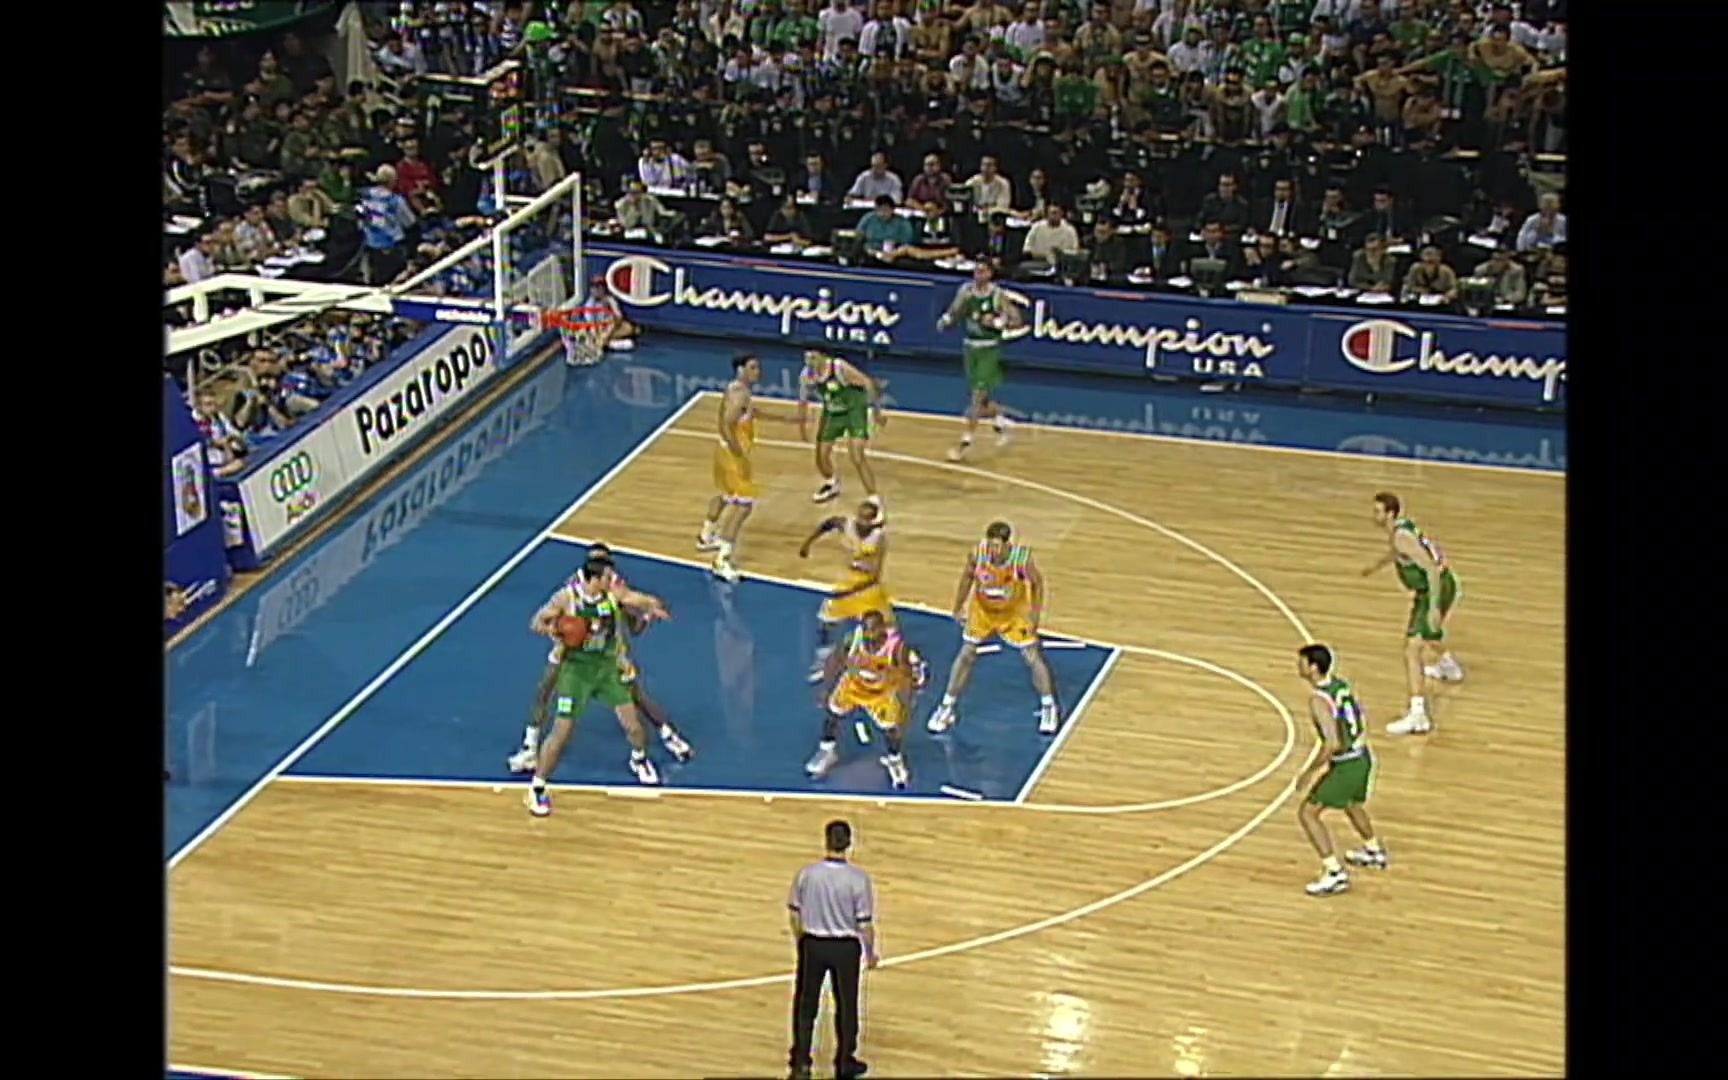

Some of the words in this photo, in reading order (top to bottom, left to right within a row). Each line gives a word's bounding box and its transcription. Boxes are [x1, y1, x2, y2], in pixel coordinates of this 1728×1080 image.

[606, 254, 900, 336] Champion
[825, 324, 892, 345] USA
[1193, 356, 1265, 378] USA
